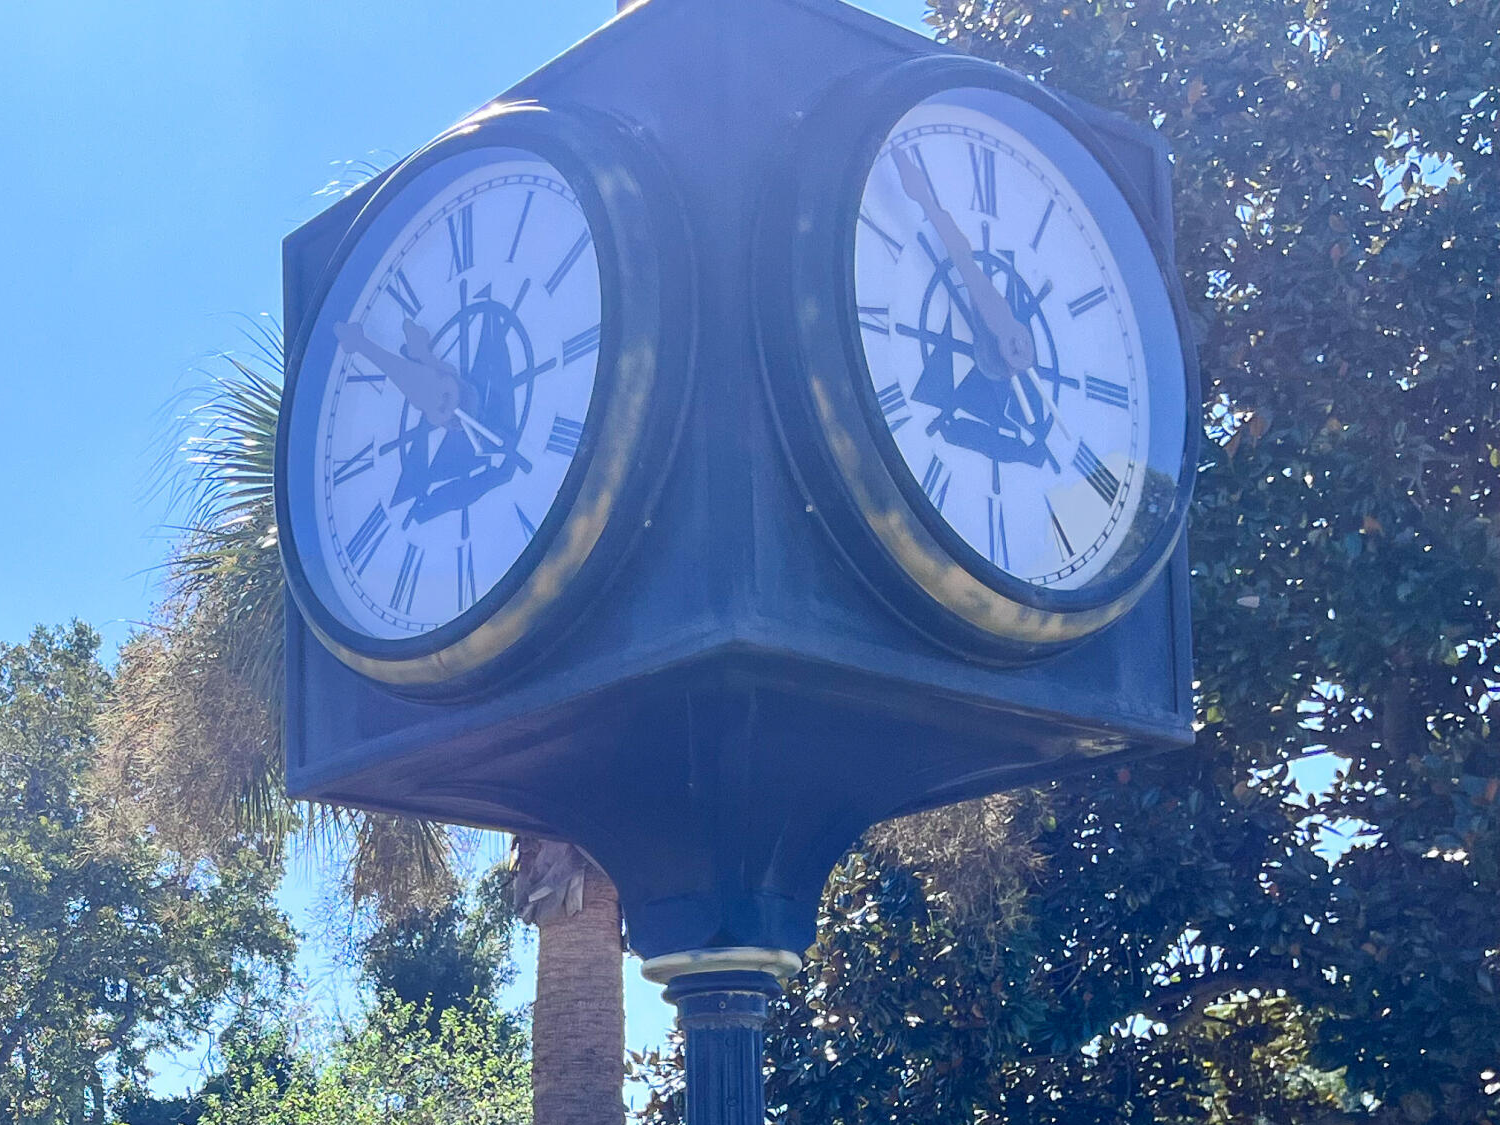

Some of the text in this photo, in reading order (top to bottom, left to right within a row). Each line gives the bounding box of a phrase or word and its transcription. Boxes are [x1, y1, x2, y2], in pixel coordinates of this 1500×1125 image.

[893, 142, 942, 222] I
[968, 142, 1000, 220] XII
[447, 203, 474, 281] XII
[506, 191, 536, 263] I
[1030, 199, 1057, 250] I
[384, 270, 425, 319] XI
[545, 229, 592, 296] II
[1068, 285, 1108, 318] II
[345, 358, 387, 395] X
[562, 323, 601, 366] III
[1084, 371, 1130, 409] III
[333, 441, 375, 487] IX
[545, 413, 585, 458] IIII
[1070, 437, 1120, 508] IIII
[345, 499, 392, 577] VIII
[987, 496, 1011, 571] VI
[1044, 495, 1076, 562] V
[390, 542, 426, 615] VII
